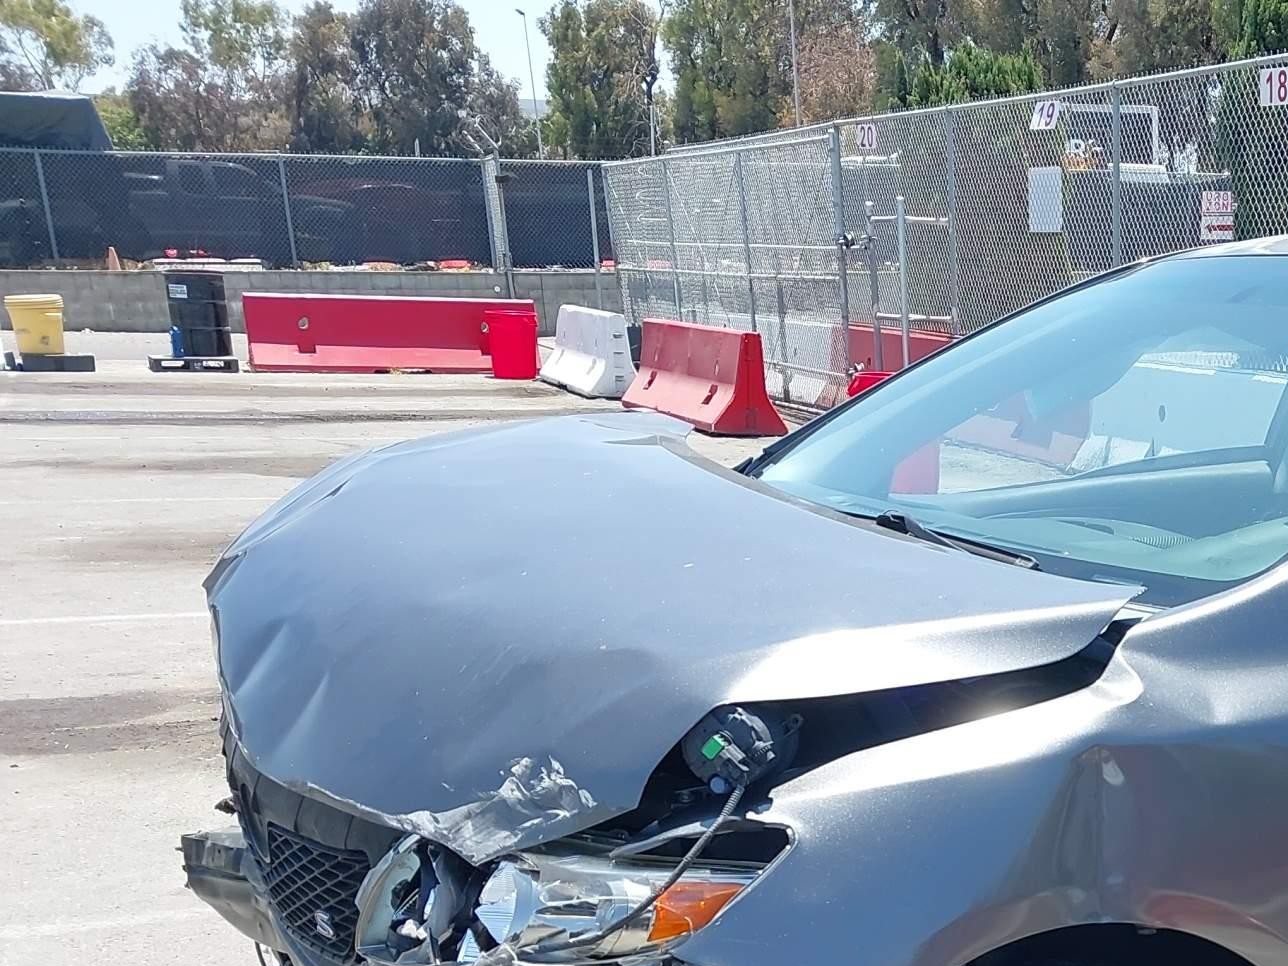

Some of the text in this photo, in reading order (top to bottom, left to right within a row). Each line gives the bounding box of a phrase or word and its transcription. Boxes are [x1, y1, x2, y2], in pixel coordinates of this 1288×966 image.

[1265, 69, 1288, 103] 18
[1037, 102, 1055, 127] 19
[860, 125, 874, 148] 20
